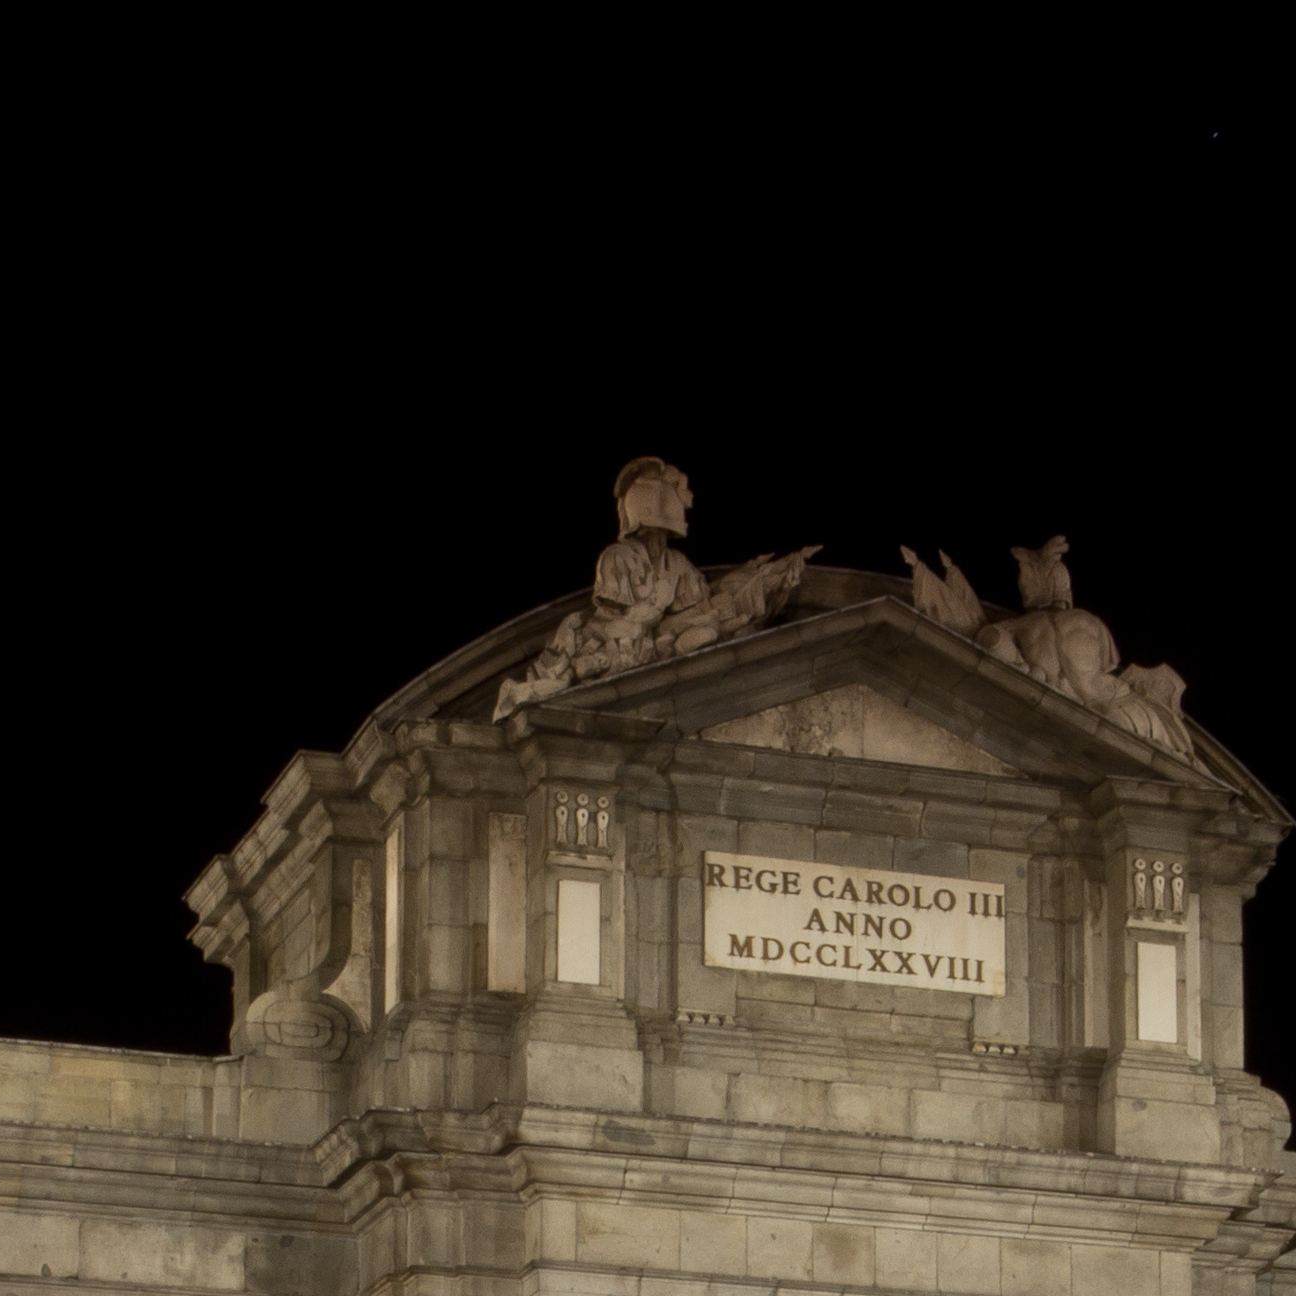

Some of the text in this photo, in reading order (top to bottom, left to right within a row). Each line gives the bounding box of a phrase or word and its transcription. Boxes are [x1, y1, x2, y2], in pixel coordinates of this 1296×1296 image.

[706, 863, 1004, 918] REGE CAROLO III
[803, 908, 912, 940] ANNO
[728, 933, 985, 983] MDCCLXXVIII
